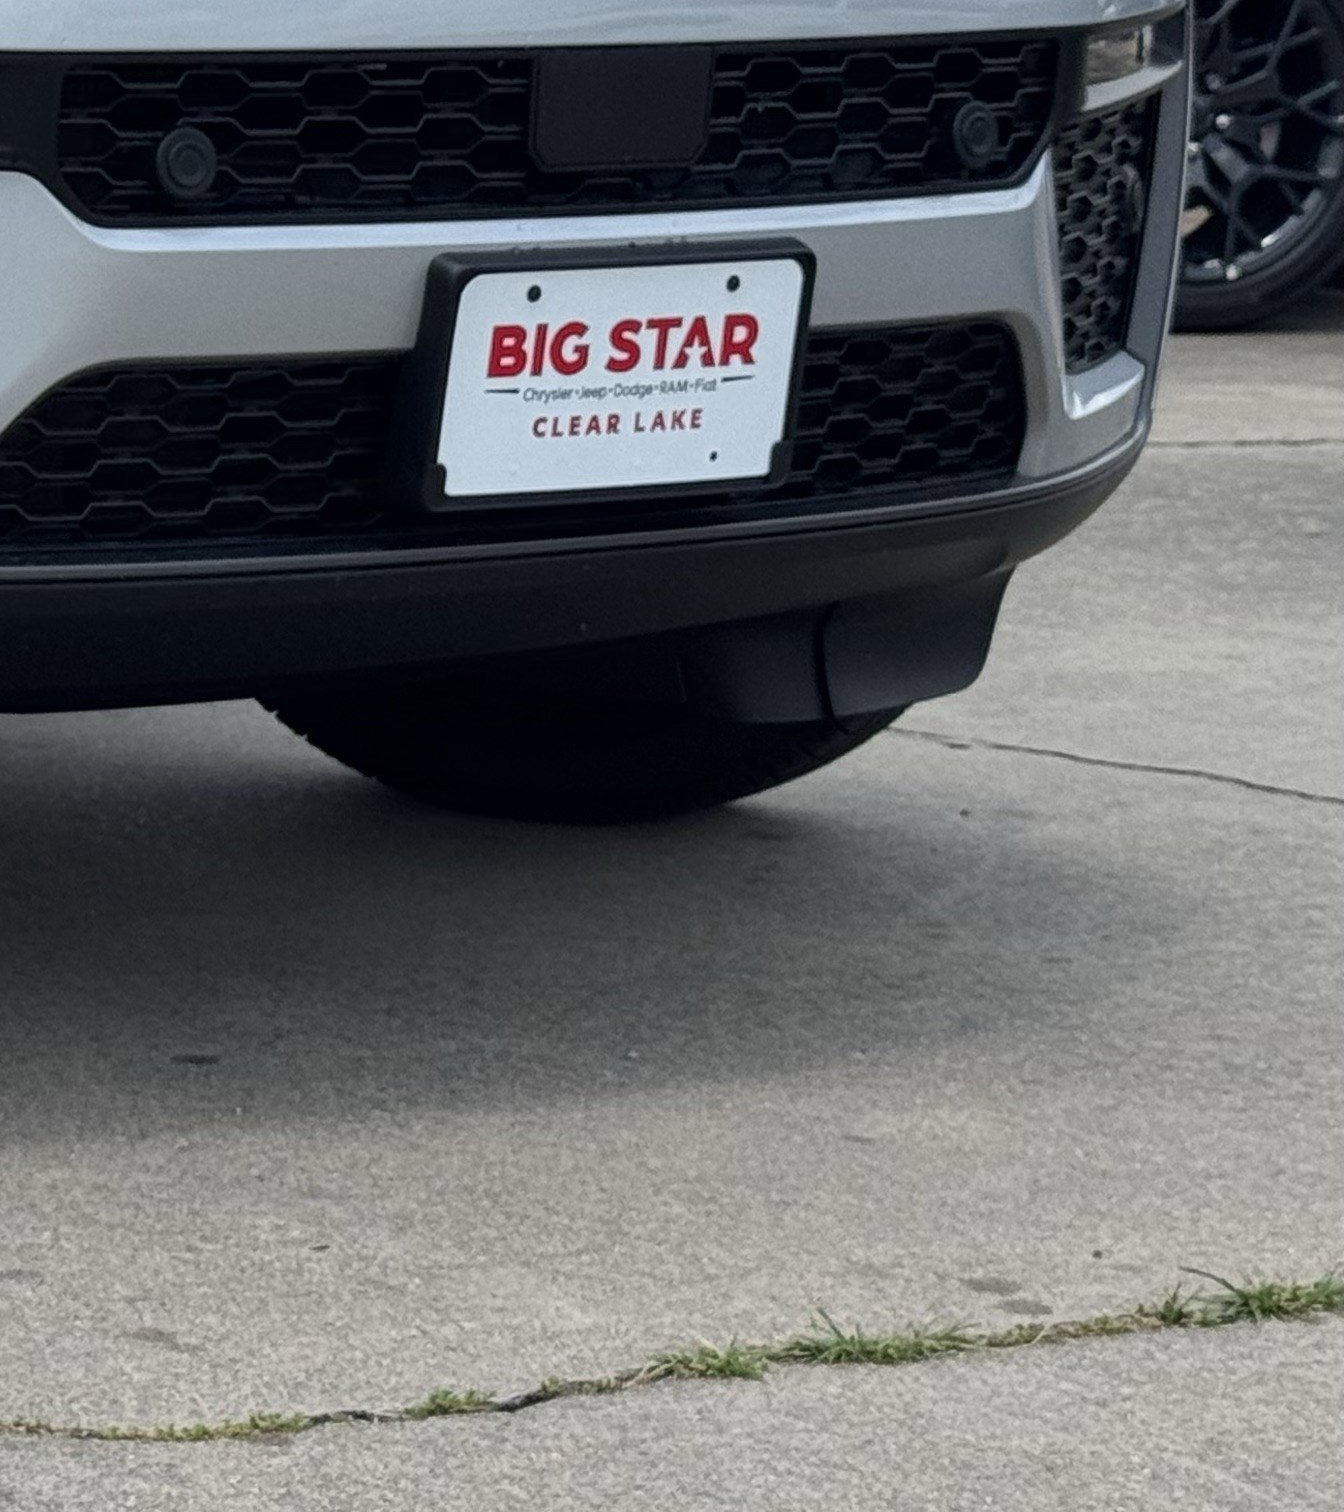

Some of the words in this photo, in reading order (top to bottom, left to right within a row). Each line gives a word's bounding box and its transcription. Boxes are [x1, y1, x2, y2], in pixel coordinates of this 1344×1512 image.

[486, 321, 590, 378] BIG
[604, 313, 760, 373] STAR
[532, 413, 620, 438] CLEAR
[633, 407, 704, 432] LAKE
